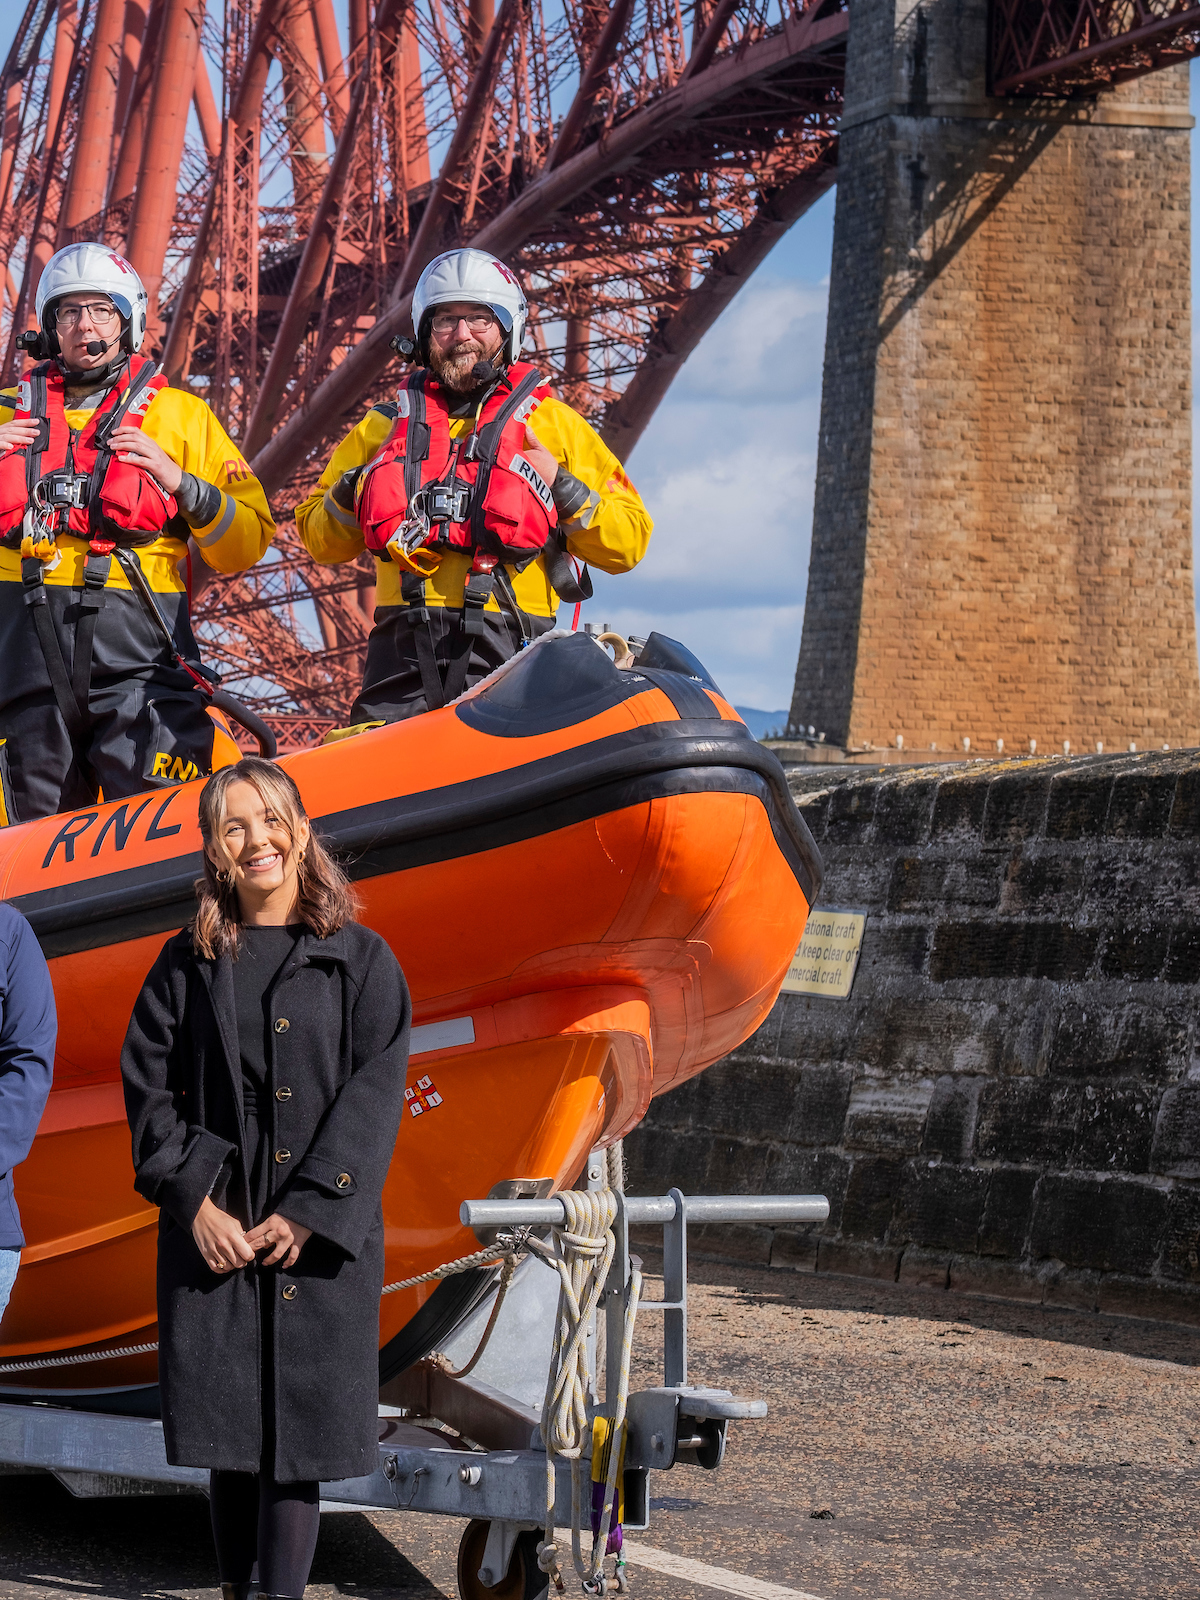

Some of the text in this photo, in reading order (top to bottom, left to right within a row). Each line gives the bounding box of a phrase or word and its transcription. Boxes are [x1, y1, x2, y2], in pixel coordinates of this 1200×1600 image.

[519, 461, 551, 504] RNLI
[41, 788, 184, 870] RNL
[804, 920, 855, 939] ational craft
[802, 942, 821, 961] keep
[823, 945, 844, 961] clear
[846, 946, 857, 962] of
